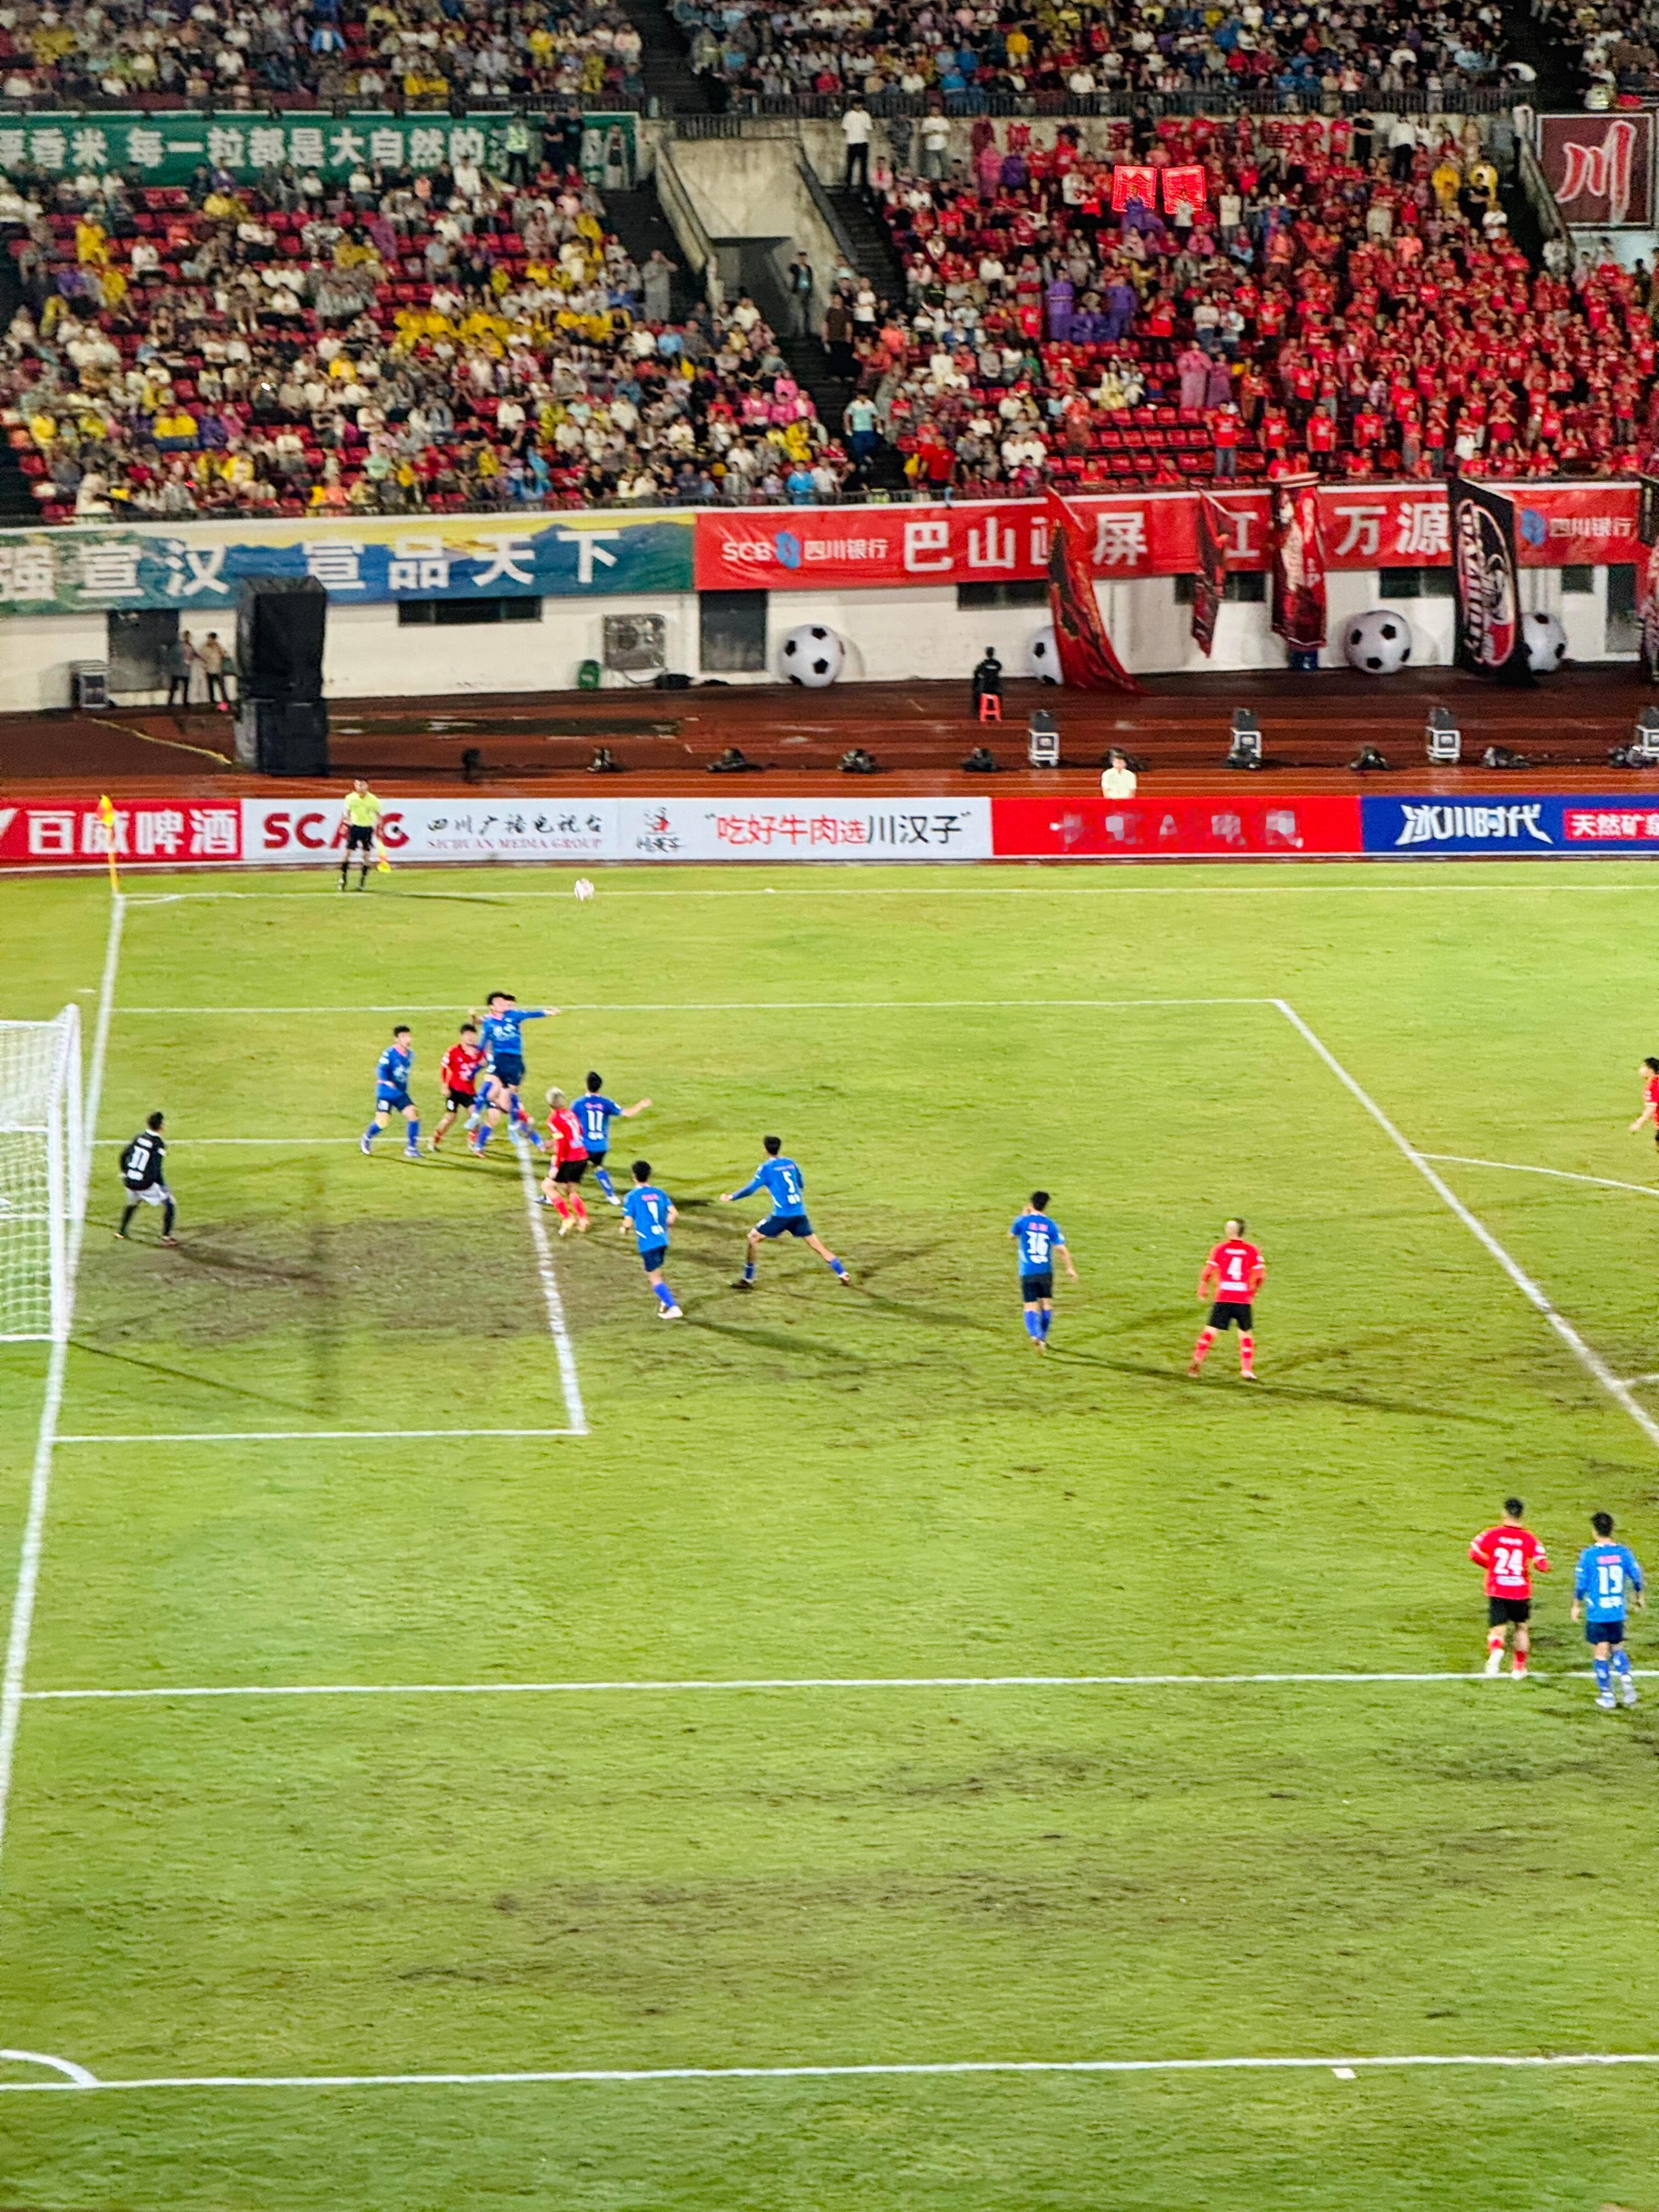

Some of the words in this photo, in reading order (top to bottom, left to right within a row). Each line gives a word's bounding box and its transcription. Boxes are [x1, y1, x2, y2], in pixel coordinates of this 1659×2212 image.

[1549, 517, 1633, 538] 四川银行
[803, 538, 888, 561] 四川银行
[26, 808, 238, 855] 百威啤酒
[1394, 804, 1554, 845] 冰川时代
[587, 1110, 603, 1132] 11
[1227, 1256, 1243, 1280] 4
[1493, 1547, 1523, 1576] 24
[1598, 1565, 1624, 1595] 19
